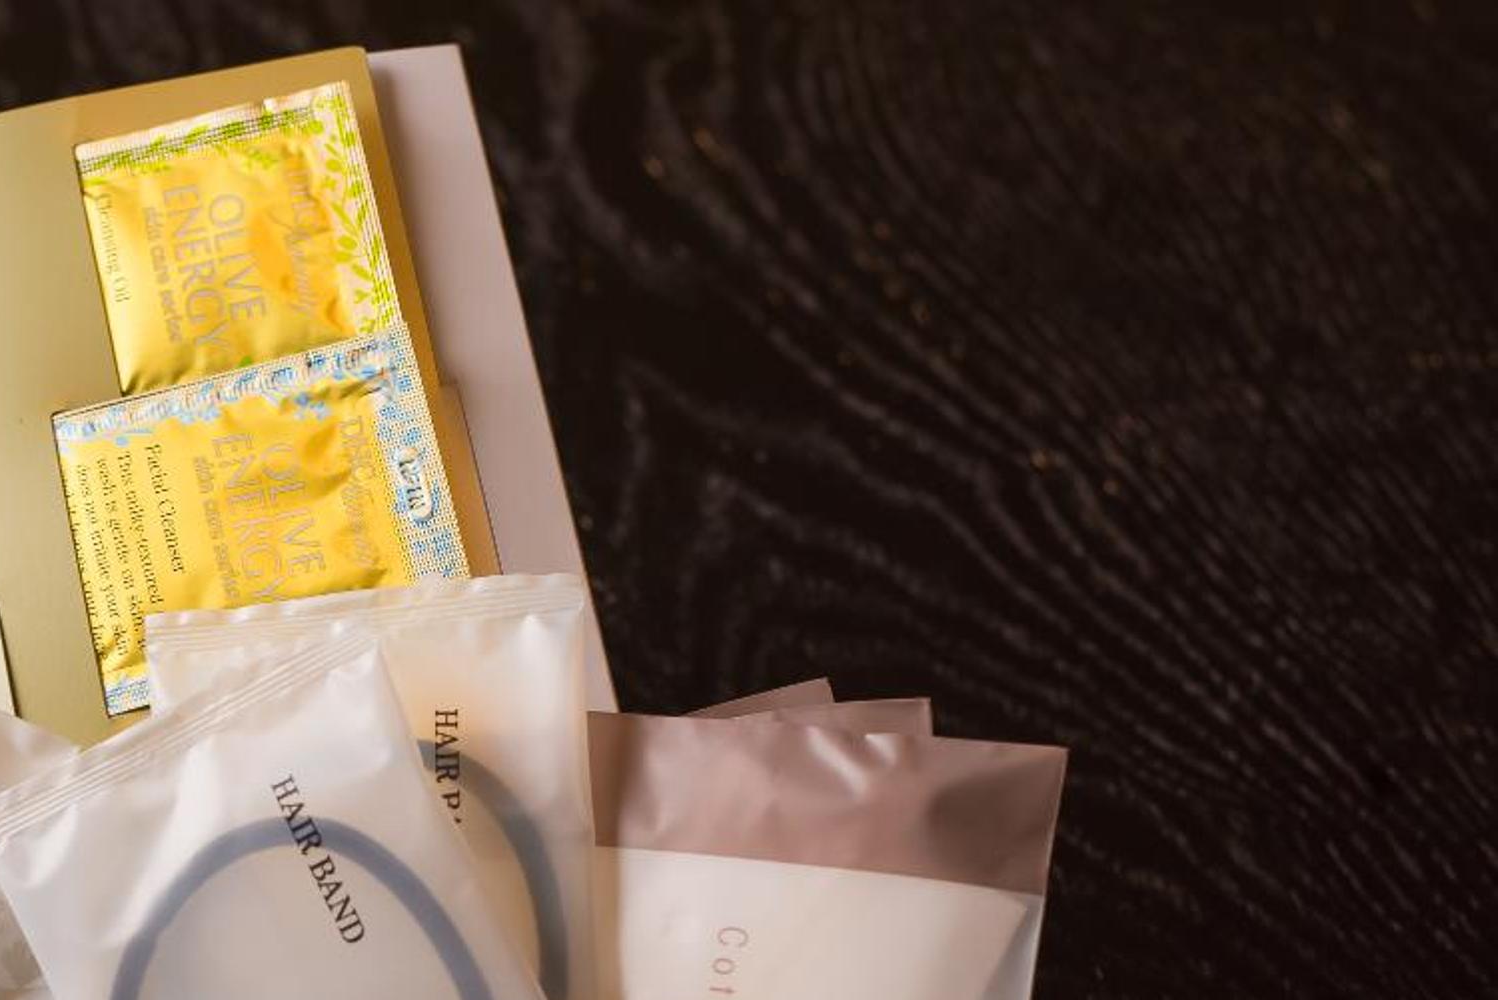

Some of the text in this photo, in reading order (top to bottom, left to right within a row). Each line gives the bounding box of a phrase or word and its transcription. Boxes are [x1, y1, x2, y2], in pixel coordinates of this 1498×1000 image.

[164, 184, 230, 347] ENERGY
[209, 193, 267, 322] OLIVE
[97, 458, 116, 497] wash
[108, 518, 129, 565] gentle
[122, 569, 135, 590] on
[117, 450, 134, 485] This
[145, 443, 185, 573] Facial Cleanser
[211, 432, 286, 602] ENERGY
[259, 441, 324, 575] OLIVE
[90, 528, 111, 580] irritate
[100, 583, 120, 619] your
[113, 624, 130, 657] skin
[435, 708, 460, 783] HAIR
[271, 774, 366, 944] HAIR BAND
